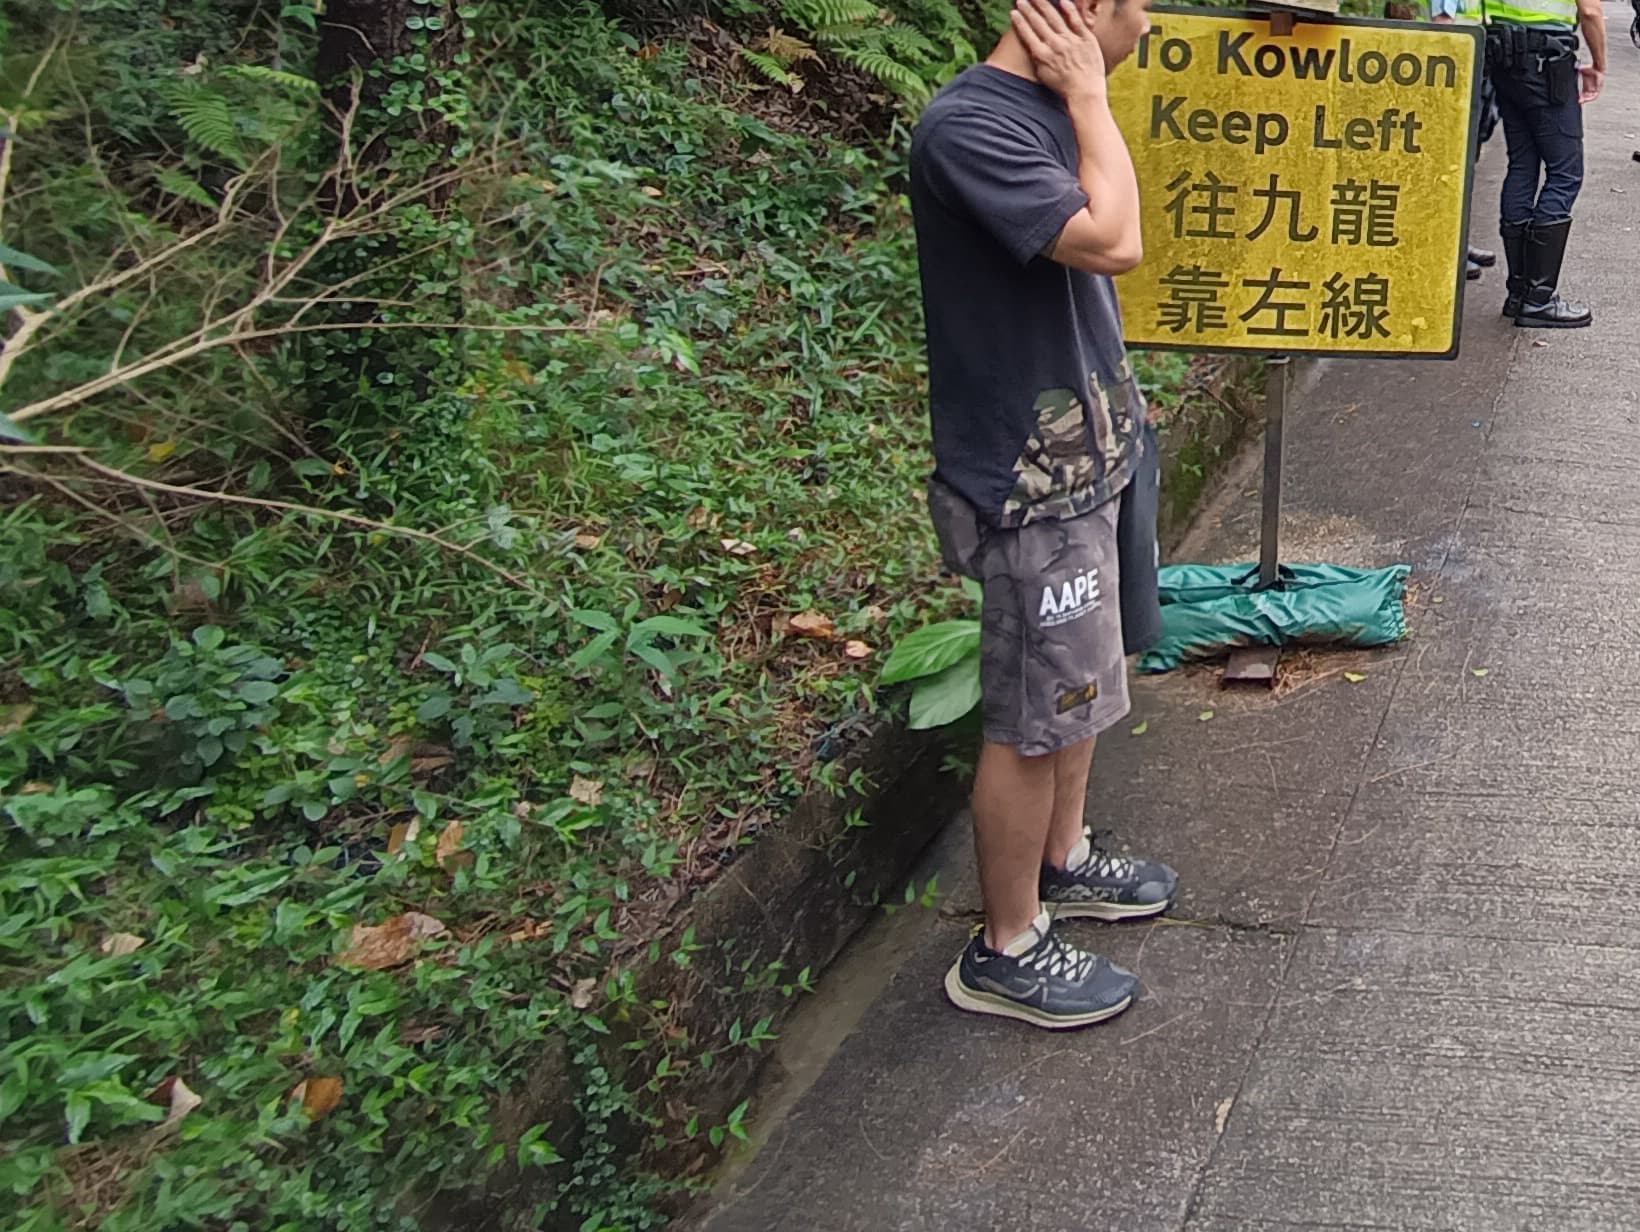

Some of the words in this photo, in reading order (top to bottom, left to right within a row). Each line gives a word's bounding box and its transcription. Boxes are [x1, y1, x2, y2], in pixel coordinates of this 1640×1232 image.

[1137, 25, 1192, 72] To
[1217, 30, 1457, 88] Kowloon
[1150, 94, 1289, 155] Keep
[1313, 105, 1423, 154] Left
[1163, 169, 1401, 247] 往九龍
[1156, 264, 1393, 340] 靠左線
[1039, 568, 1100, 616] AAPE
